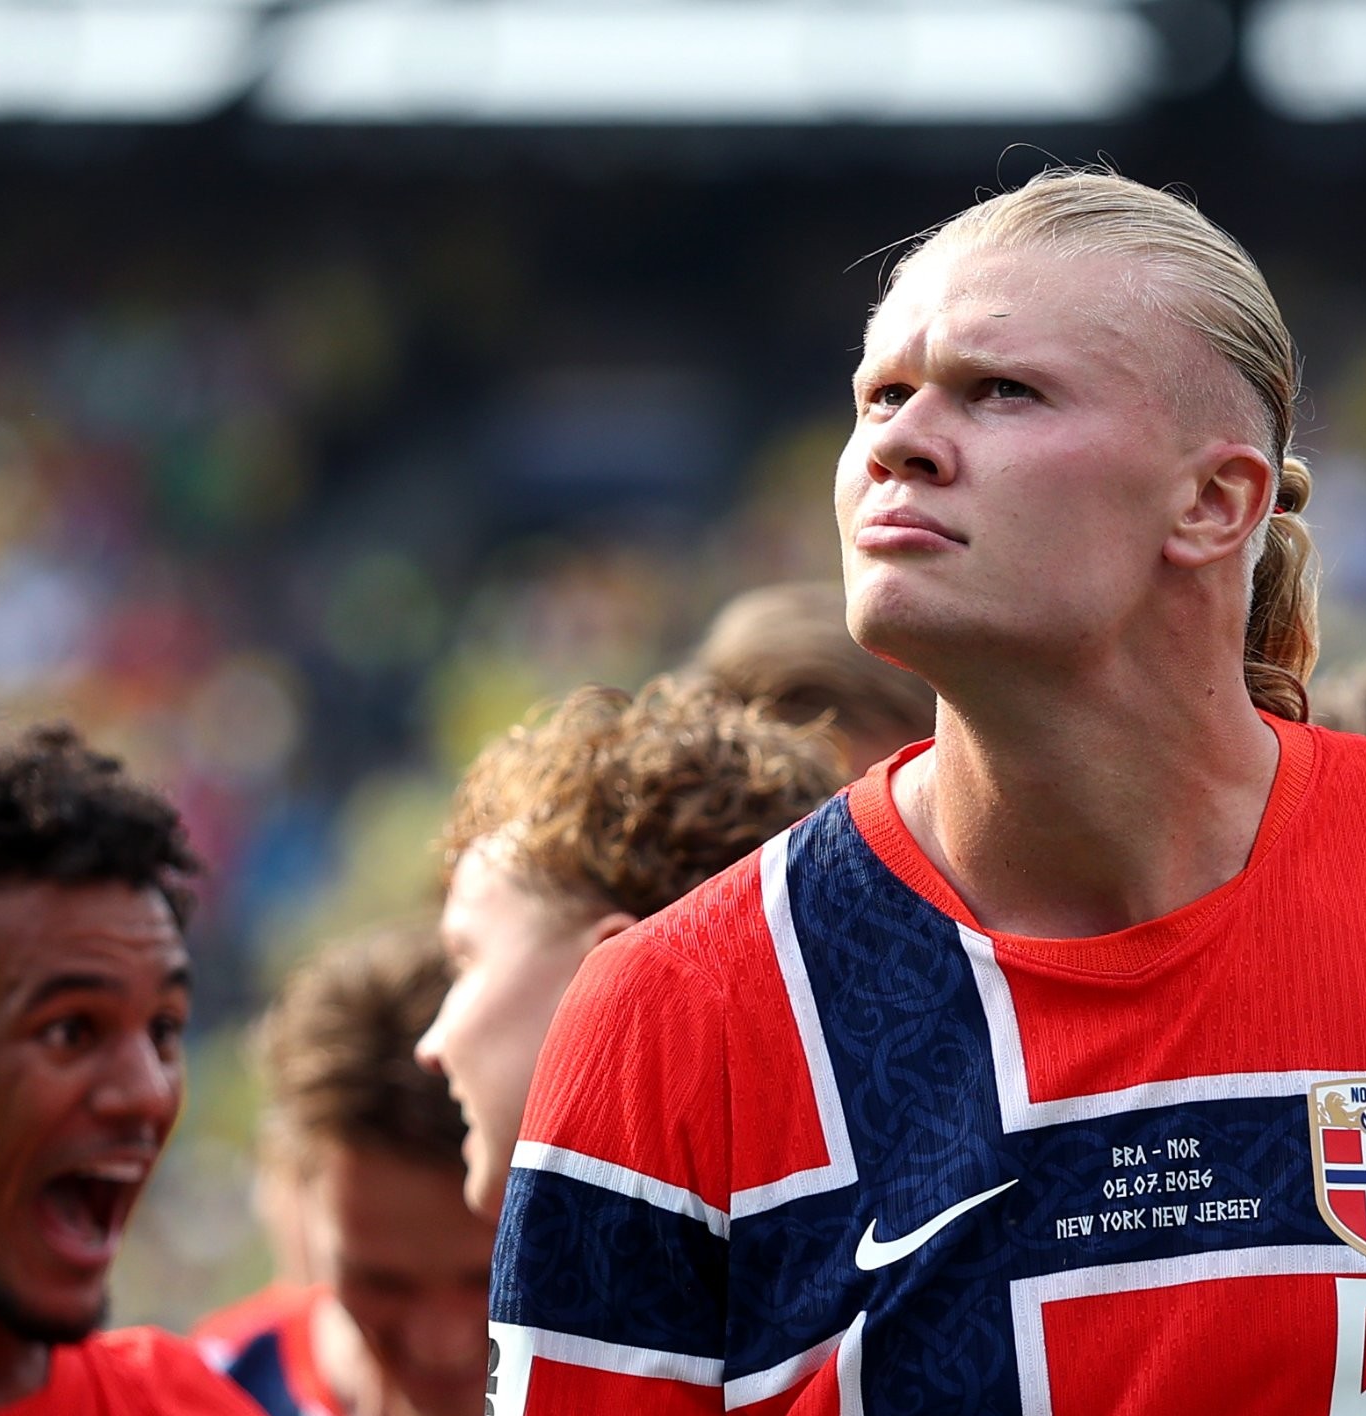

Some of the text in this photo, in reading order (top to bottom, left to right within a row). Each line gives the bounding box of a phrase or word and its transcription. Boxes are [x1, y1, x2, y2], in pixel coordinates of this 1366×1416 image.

[1112, 1145, 1147, 1168] BRA
[1167, 1138, 1201, 1160] NOR
[1103, 1168, 1214, 1199] 05.07.2026
[1056, 1198, 1261, 1240] NEW YORK NEW JERSEY
